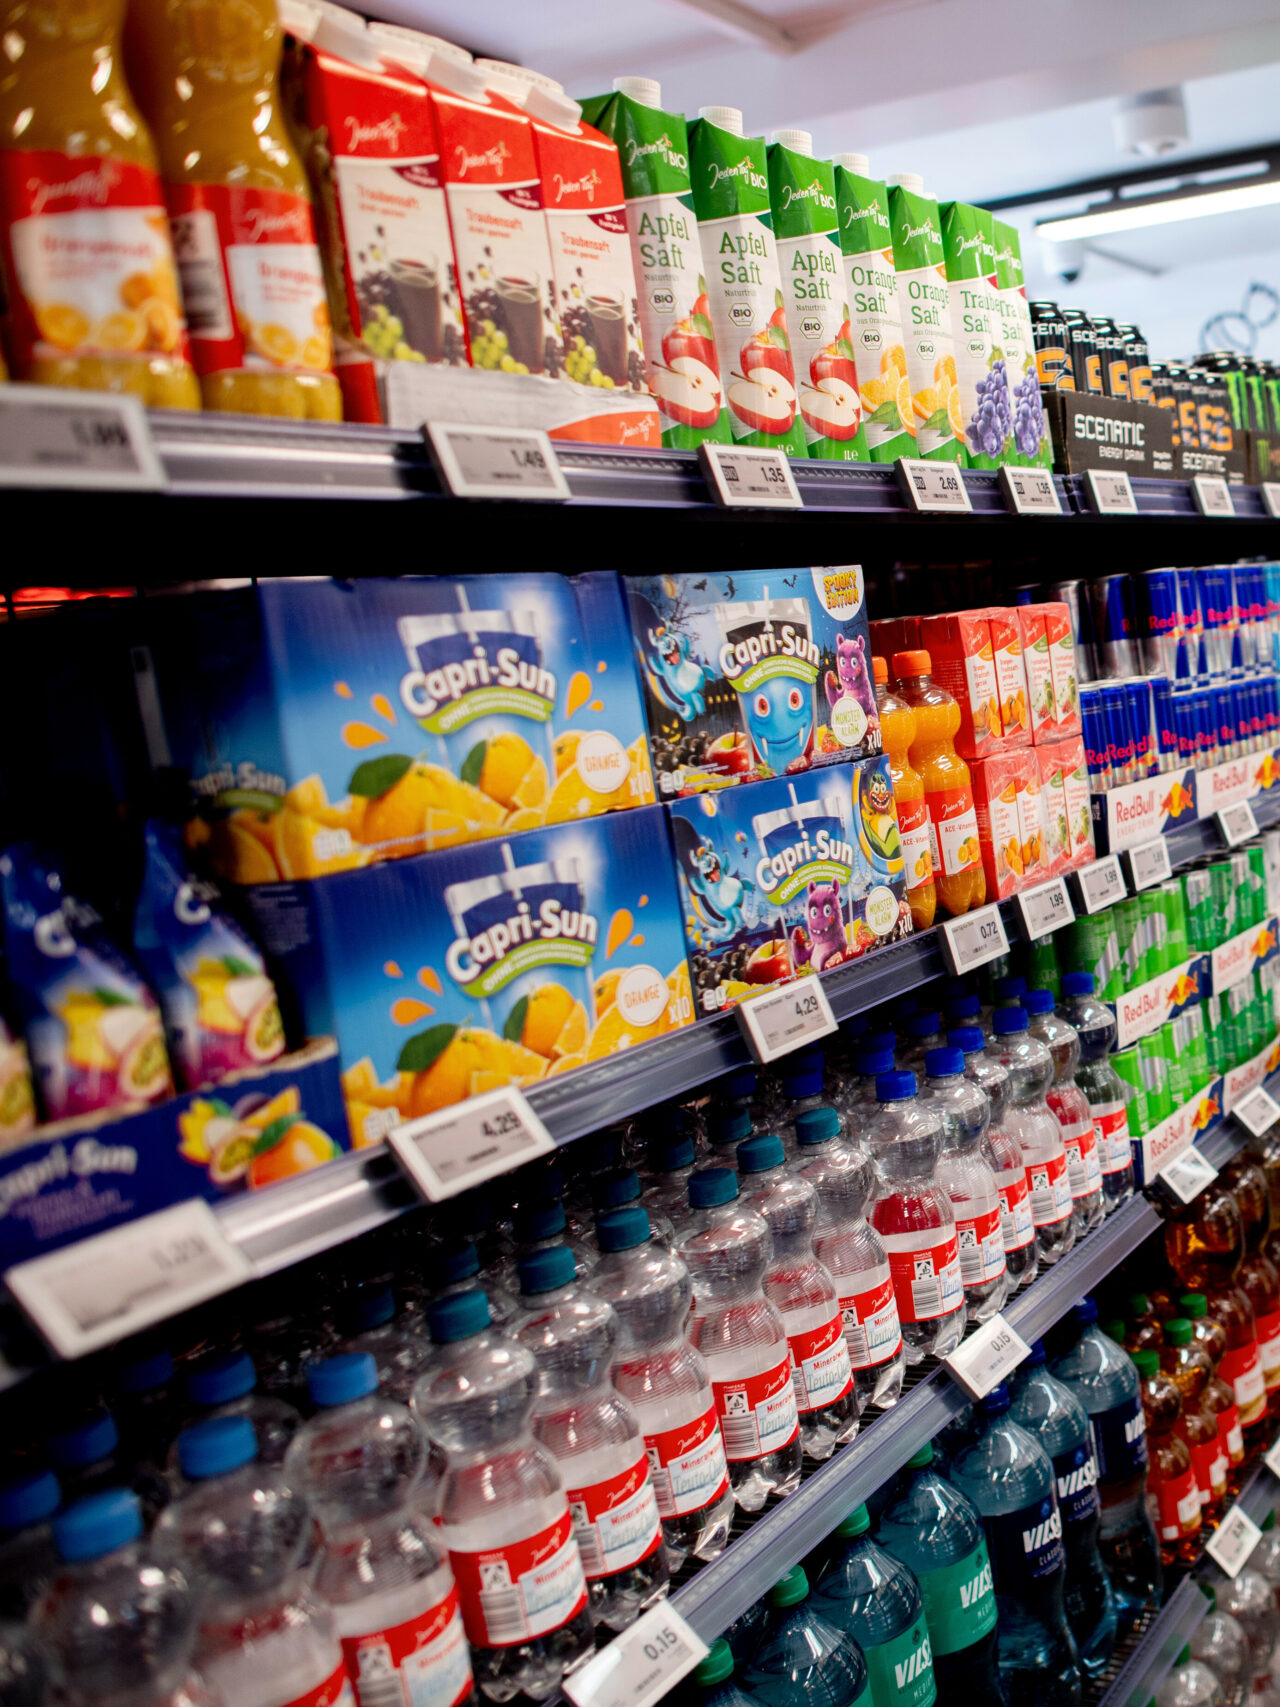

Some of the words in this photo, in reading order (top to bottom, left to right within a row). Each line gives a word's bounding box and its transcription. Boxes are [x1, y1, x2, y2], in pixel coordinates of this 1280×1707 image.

[626, 138, 655, 166] Jeden
[668, 150, 688, 169] BIO
[708, 163, 738, 189] Jeden
[737, 160, 750, 184] Tag
[750, 172, 767, 189] BIO
[553, 173, 581, 202] Jeden
[783, 185, 809, 210] Jeden
[808, 183, 820, 206] Tag
[820, 193, 836, 209] BIO
[638, 212, 690, 244] Apfel
[844, 206, 870, 229] Jeden
[878, 213, 890, 229] BIO
[902, 223, 924, 246] Jeden
[931, 229, 942, 245] BIO
[641, 244, 685, 270] Saft
[719, 232, 768, 260] Apfel
[721, 261, 763, 286] Saft
[792, 250, 838, 277] Apfel
[793, 279, 832, 300] Saft
[851, 266, 897, 296] Orange
[653, 294, 673, 304] BIO
[854, 293, 887, 315] Saft
[908, 281, 949, 309] Orange
[733, 308, 751, 318] BIO
[911, 305, 940, 327] Saft
[803, 322, 821, 332] BIO
[963, 315, 991, 334] Saft
[864, 334, 880, 343] BIO
[1074, 413, 1146, 447] SCENATIC
[511, 449, 546, 469] 1.49
[760, 466, 785, 483] 1.35
[939, 476, 958, 490] 2.69
[823, 570, 857, 592] SPOOKY
[826, 588, 859, 610] EDITION
[719, 621, 821, 680] Capri-Sun
[400, 645, 558, 718] Capri-Sun
[835, 709, 862, 724] MONSTER
[584, 752, 621, 773] ORANGE
[756, 829, 854, 893] Capri-Sun
[1104, 870, 1118, 884] 1.99
[869, 897, 894, 916] MONSTER
[1049, 892, 1064, 908] 1.99
[445, 899, 598, 983] Capri-Sun
[980, 921, 998, 939] 0.72
[623, 982, 661, 1009] ORANGE
[794, 995, 819, 1016] 4.29
[642, 1627, 680, 1662] 0.15
